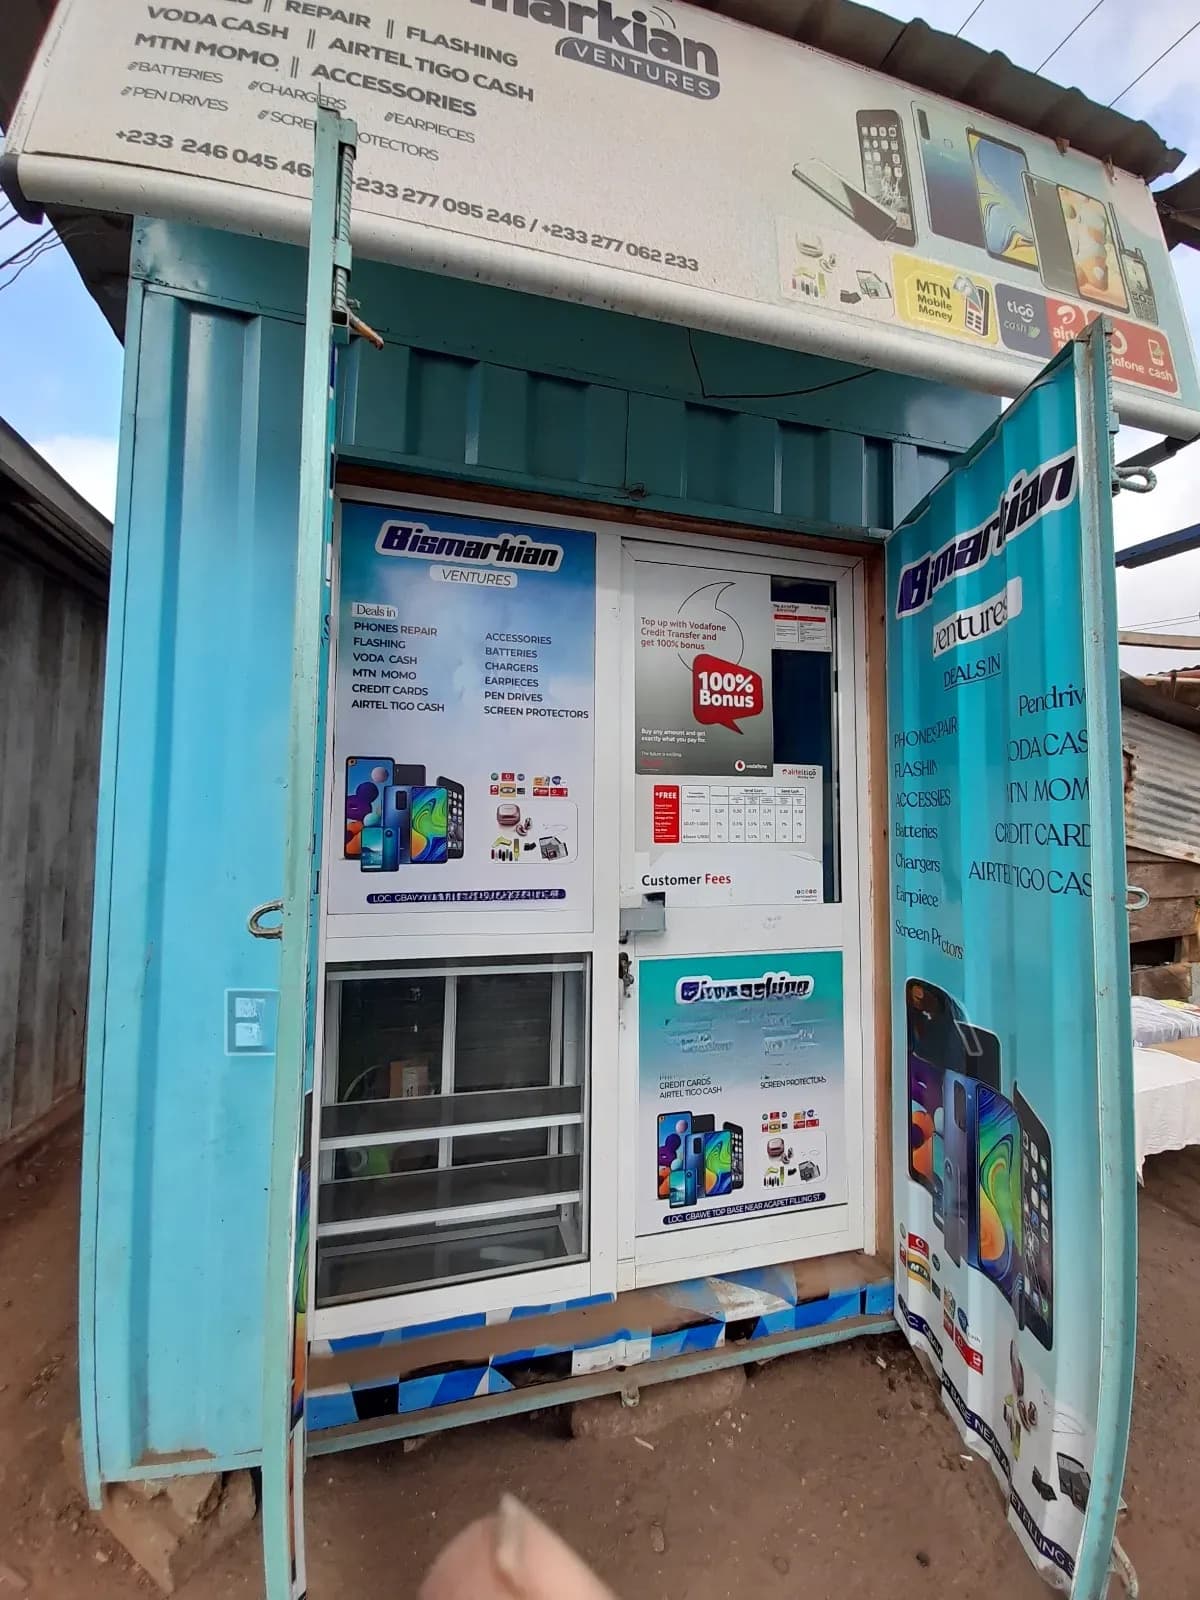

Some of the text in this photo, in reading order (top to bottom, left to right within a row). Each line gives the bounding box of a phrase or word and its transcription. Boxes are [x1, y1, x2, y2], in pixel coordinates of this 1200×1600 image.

[285, 0, 518, 67] REPAIR FLASHING
[469, 0, 719, 77] arkian
[148, 6, 534, 102] VODA CASH AIRTEL TIGO CASH
[135, 33, 191, 53] MTN
[311, 64, 477, 117] ACCESSORIES
[573, 41, 712, 97] VENTURES
[169, 92, 229, 112] DRIVES
[357, 130, 440, 162] OTECTORS
[115, 130, 174, 150] +233
[181, 139, 228, 160] 246
[232, 149, 278, 171] 045
[281, 160, 315, 178] 46
[402, 188, 439, 208] 277
[443, 199, 483, 219] 095
[487, 208, 526, 229] 246
[541, 224, 588, 244] +233
[591, 234, 623, 252] 277
[626, 243, 662, 263] 062
[665, 252, 699, 272] 233
[916, 278, 950, 299] MTN
[917, 294, 953, 311] Mobile
[918, 303, 953, 323] Money
[1003, 319, 1027, 334] cash
[1148, 366, 1173, 382] cash
[381, 525, 559, 567] Bismarkian
[442, 569, 511, 586] VENTURES
[356, 604, 396, 617] Deals in
[354, 621, 437, 636] PHONES REPAIR
[641, 617, 727, 632] Top up with Vodafone
[353, 637, 406, 649] FLASHING
[485, 632, 552, 645] ACCESSORIES
[641, 628, 717, 641] Credit Transfer and
[485, 647, 537, 659] BATTERIES
[641, 639, 705, 650] get 100% bonus
[353, 652, 417, 665] VODA CASH
[352, 668, 416, 680] MTN MOMO
[485, 662, 538, 673] CHARGERS
[943, 660, 987, 688] DEALS
[352, 684, 428, 696] CREDIT CARDS
[485, 676, 539, 687] EARPIECES
[698, 671, 754, 693] 100%
[484, 691, 543, 702] PEN DRIVES
[700, 689, 754, 708] Bonus
[1019, 686, 1086, 717] Pendriv
[351, 699, 445, 712] AIRTEL TIGO CASH
[484, 705, 589, 718] SCREEN PROTECTORS
[641, 728, 651, 736] Buy
[1007, 729, 1088, 761] ODA CAS
[894, 760, 937, 779] FLASHIN
[1007, 777, 1089, 803] TN MOM
[895, 822, 938, 839] Batteries
[1035, 823, 1091, 847] CARD
[895, 852, 941, 874] Chargers
[641, 873, 732, 887] Customer Fees
[1047, 870, 1091, 897] CAS
[895, 920, 930, 942] Screen
[659, 1077, 712, 1090] CREDIT CARDS
[659, 1086, 722, 1099] AIRTEL TIGO CASH
[685, 1210, 712, 1221] GBAWE
[712, 1208, 726, 1217] TOP
[726, 1206, 745, 1215] BASE
[745, 1203, 763, 1212] NEAR
[763, 1199, 788, 1209] AGAPET
[789, 1195, 813, 1205] FILLING
